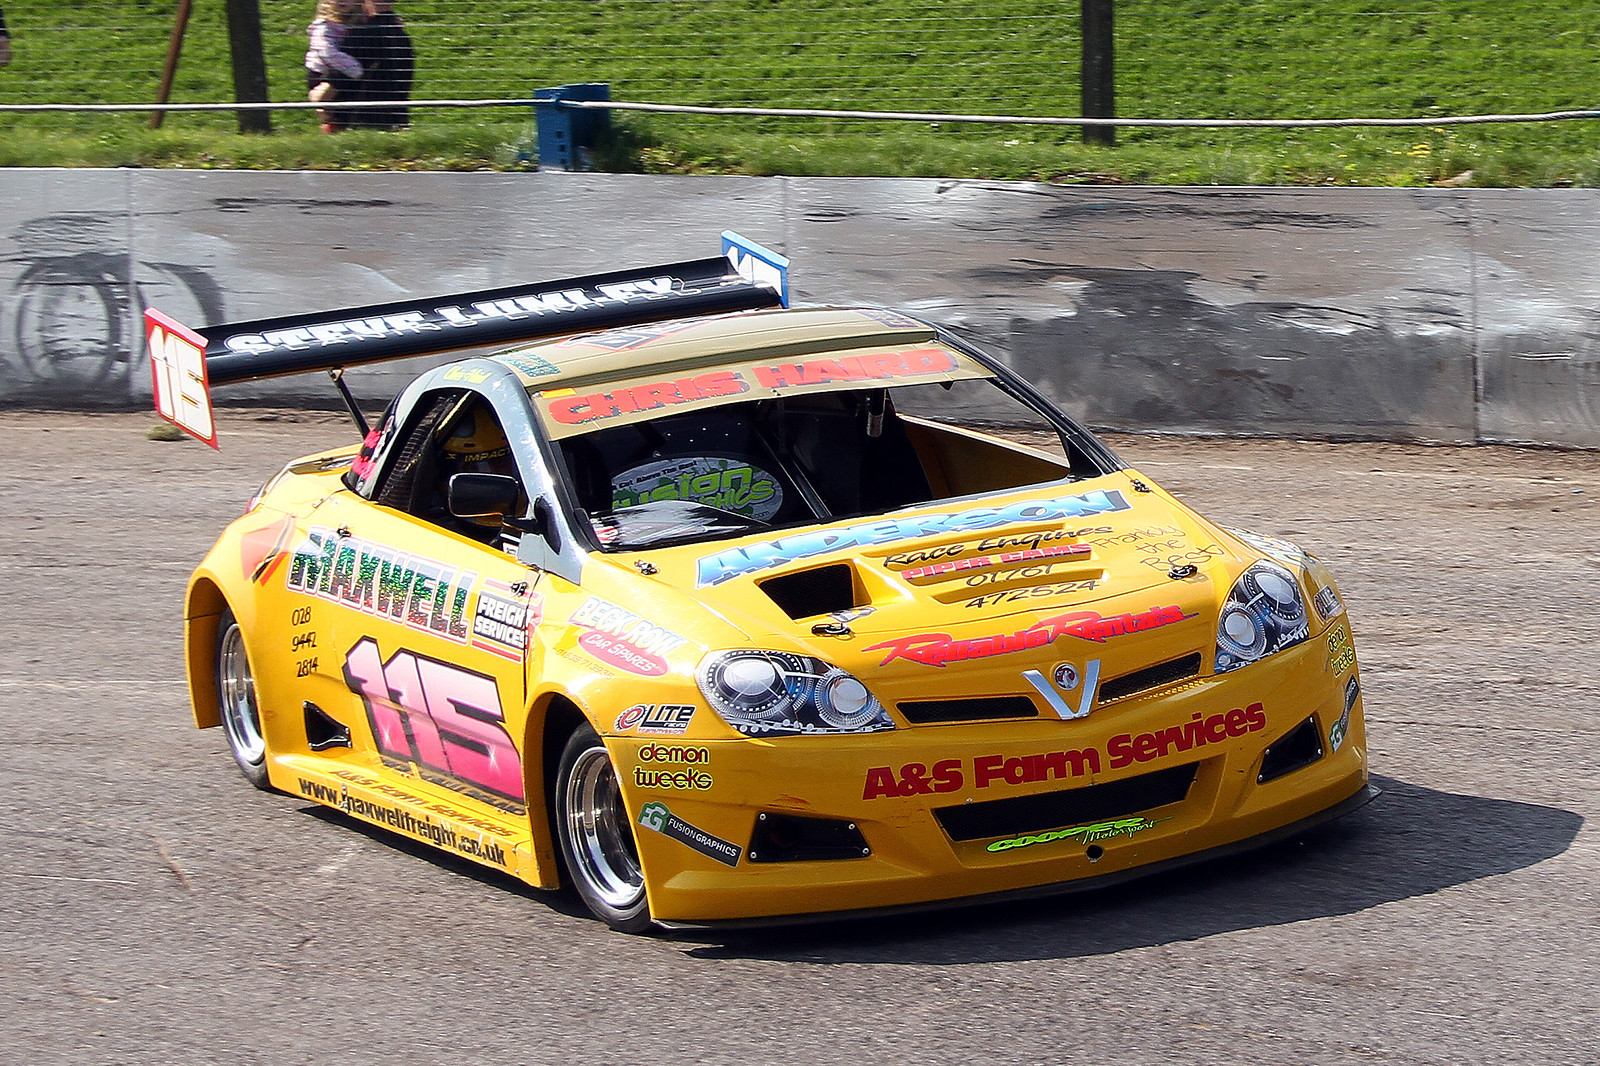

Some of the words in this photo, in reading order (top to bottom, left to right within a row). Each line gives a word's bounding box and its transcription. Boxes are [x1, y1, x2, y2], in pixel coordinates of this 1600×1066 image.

[224, 310, 441, 357] STEVE
[434, 275, 700, 329] LUMLEY
[150, 325, 212, 440] 115
[549, 371, 750, 425] CHRIS
[752, 349, 959, 388] HAIRD
[695, 490, 1131, 588] ANDERSON
[884, 544, 965, 567] Race
[977, 525, 1114, 551] Engines
[901, 556, 993, 580] PIPER
[1000, 544, 1092, 563] CAMS
[287, 526, 477, 645] MAXWELL
[291, 606, 311, 626] 028
[478, 594, 535, 629] FREIGHT
[568, 597, 640, 637] BECK
[620, 619, 689, 657] ROW
[473, 615, 528, 650] SERVICES
[864, 632, 1051, 668] Reliable
[1026, 605, 1195, 643] Rentals
[296, 656, 318, 677] 2814
[585, 634, 612, 650] CAR
[608, 644, 656, 672] SPARES
[342, 635, 526, 805] 115
[638, 742, 709, 764] demon
[862, 759, 963, 800] A&S
[974, 747, 1101, 788] Farm
[1106, 702, 1267, 769] Services
[633, 766, 713, 790] tweeks
[987, 817, 1146, 851] COOPER
[1076, 818, 1160, 845] Motorsport
